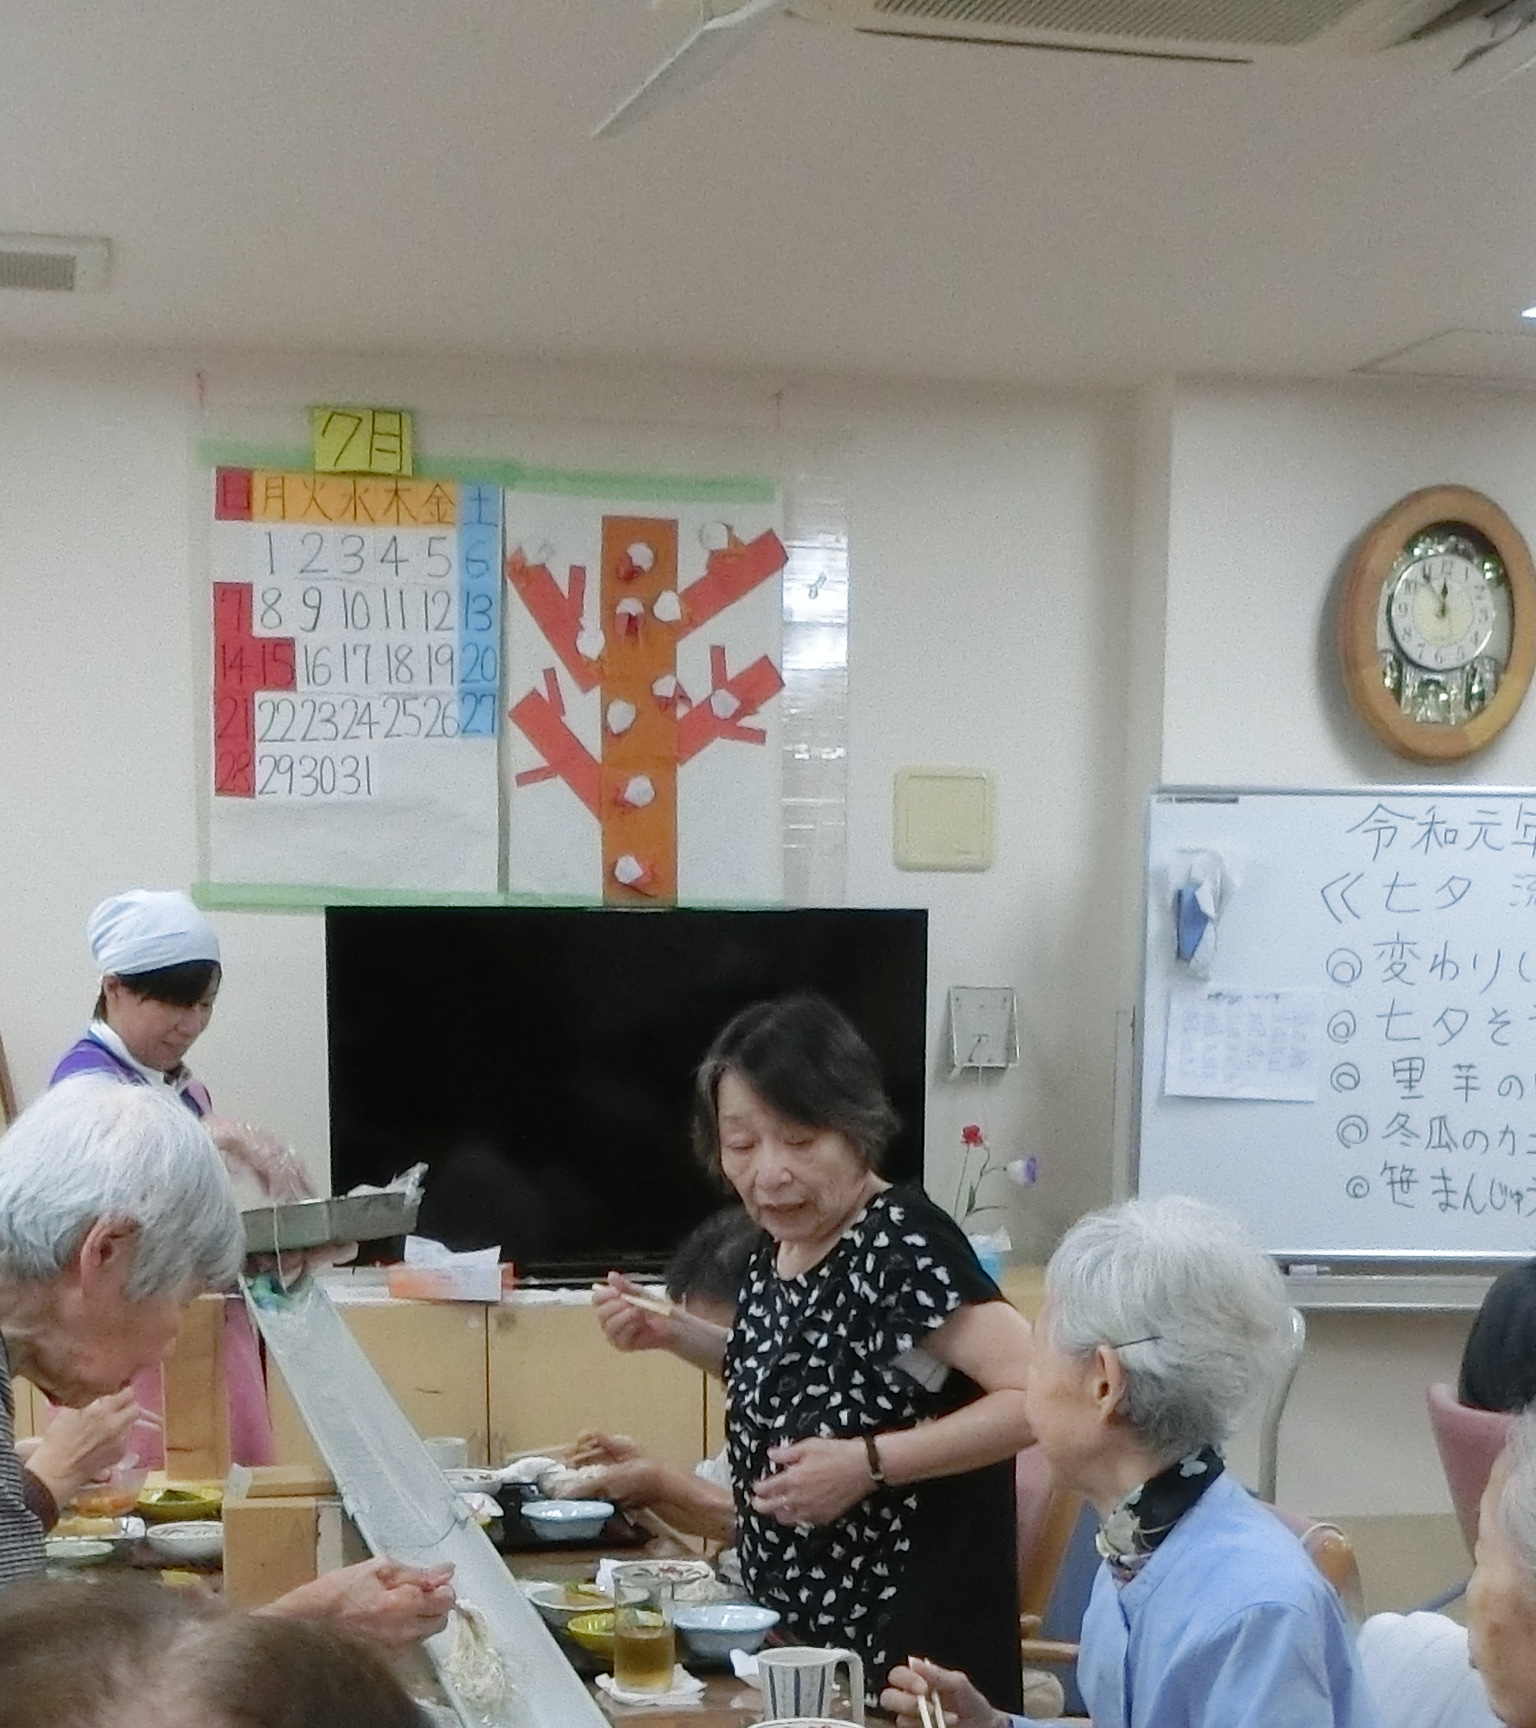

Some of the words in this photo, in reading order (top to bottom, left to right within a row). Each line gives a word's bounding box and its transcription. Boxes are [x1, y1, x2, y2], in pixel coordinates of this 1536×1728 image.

[321, 410, 403, 471] 7月
[265, 531, 275, 574] 1
[299, 532, 328, 574] 2
[341, 535, 365, 574] 3
[380, 535, 409, 577] 4
[427, 537, 452, 578] 5
[261, 587, 282, 630] 8
[300, 586, 322, 632] 9
[342, 589, 371, 630] 10
[383, 588, 406, 630] 11
[424, 590, 454, 632] 12
[465, 591, 493, 632] 13
[222, 643, 254, 682] 14
[304, 643, 332, 686] 16
[342, 643, 372, 685] 17
[386, 644, 414, 685] 18
[427, 643, 454, 686] 19
[460, 643, 497, 683] 20
[258, 699, 296, 742] 22
[300, 700, 339, 742] 23
[341, 700, 378, 739] 24
[383, 697, 422, 739] 25
[423, 699, 460, 739] 26
[461, 692, 496, 735] 27
[258, 754, 293, 795] 29
[299, 755, 336, 796] 30
[341, 755, 372, 795] 31
